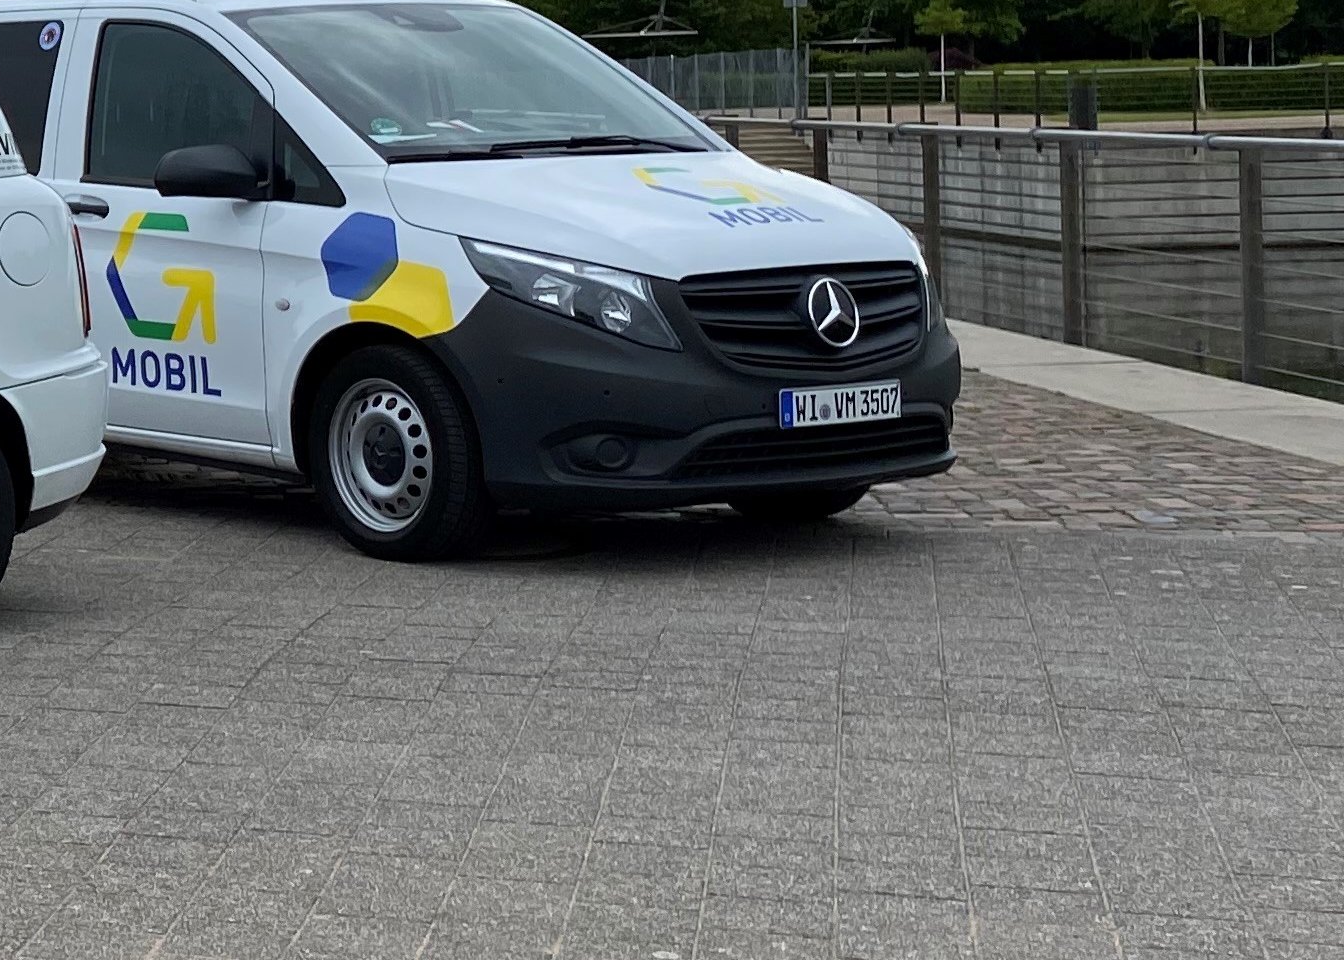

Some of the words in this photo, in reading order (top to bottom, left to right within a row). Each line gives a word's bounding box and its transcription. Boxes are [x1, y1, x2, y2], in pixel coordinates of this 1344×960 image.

[708, 206, 824, 228] MOBIL
[111, 346, 222, 397] MOBIL
[795, 394, 818, 423] WI
[834, 391, 857, 419] VM
[859, 386, 899, 417] 3507
